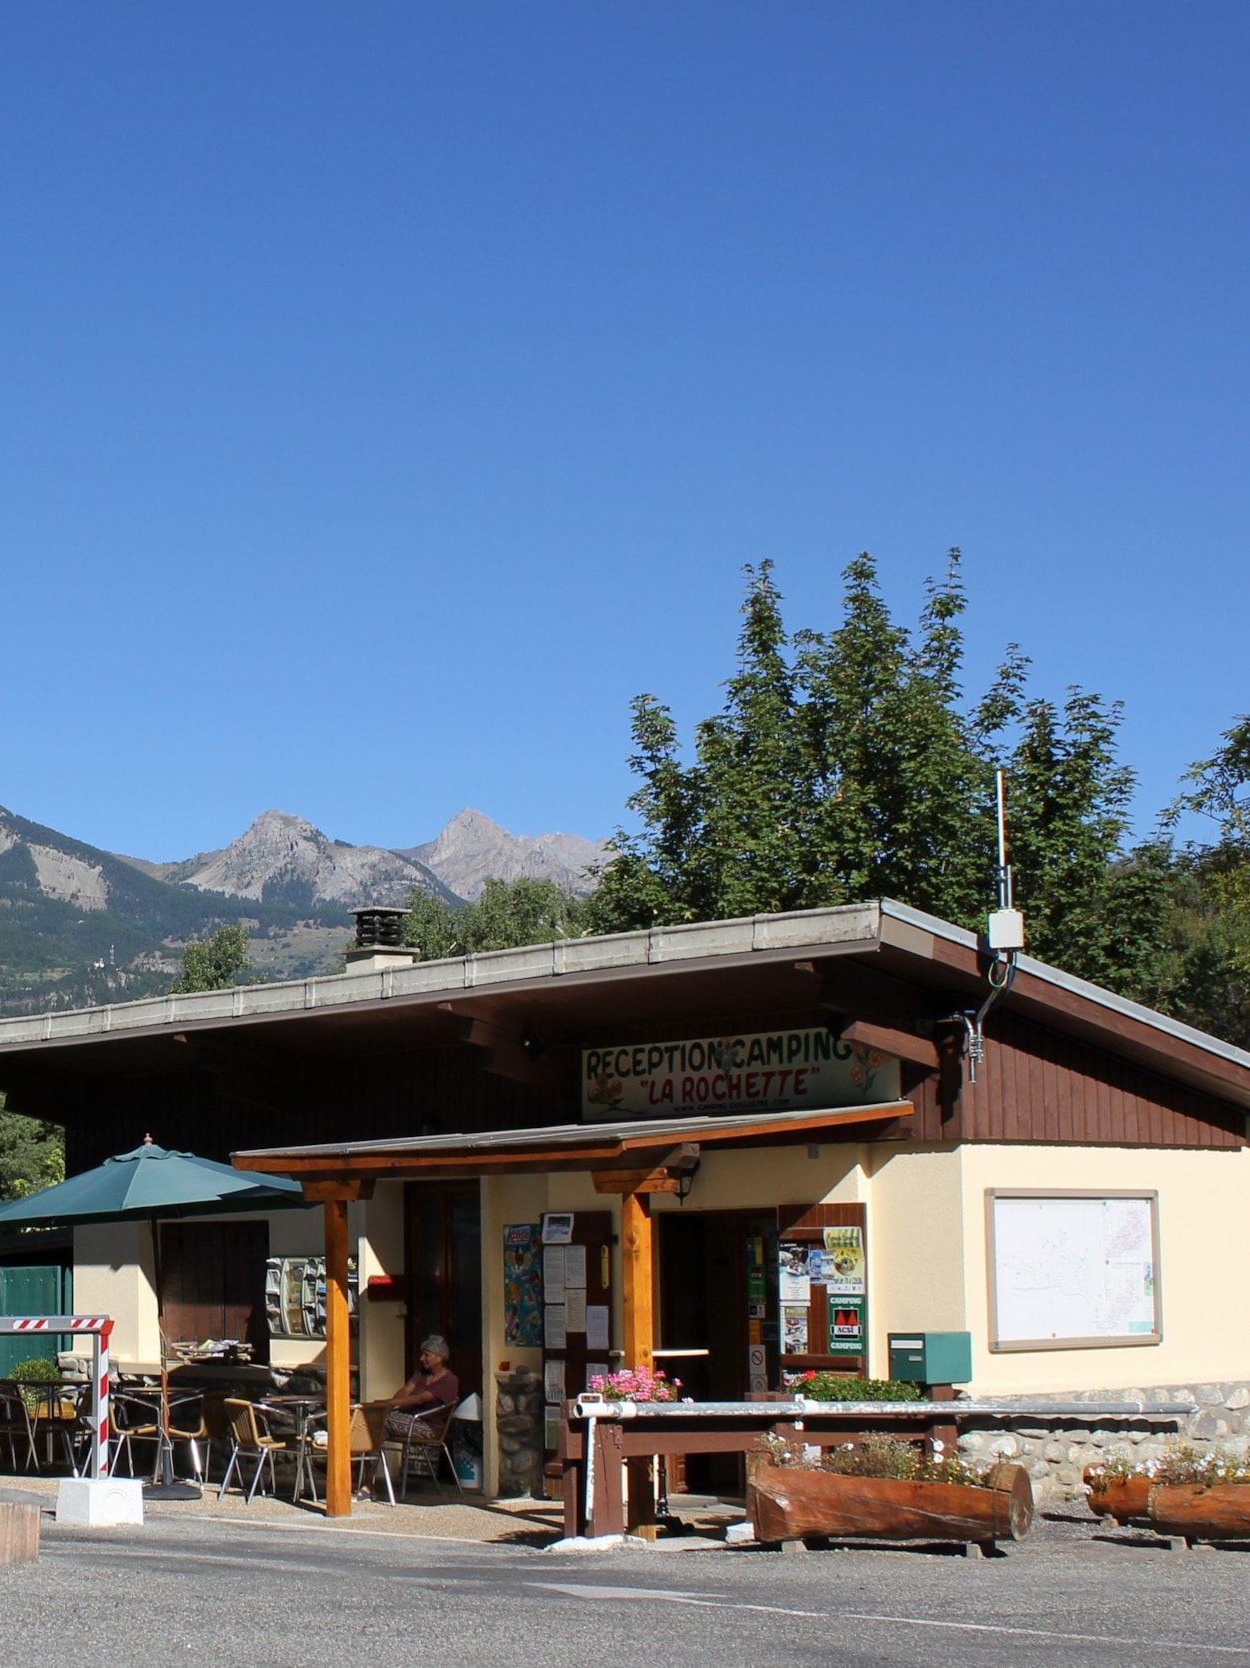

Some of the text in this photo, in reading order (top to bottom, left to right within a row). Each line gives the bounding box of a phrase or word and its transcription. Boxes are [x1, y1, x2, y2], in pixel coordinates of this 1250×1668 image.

[586, 1032, 853, 1080] RECEPTION CAMPING
[680, 1067, 821, 1102] ROCHETTE"
[830, 1342, 862, 1350] CAMPING
